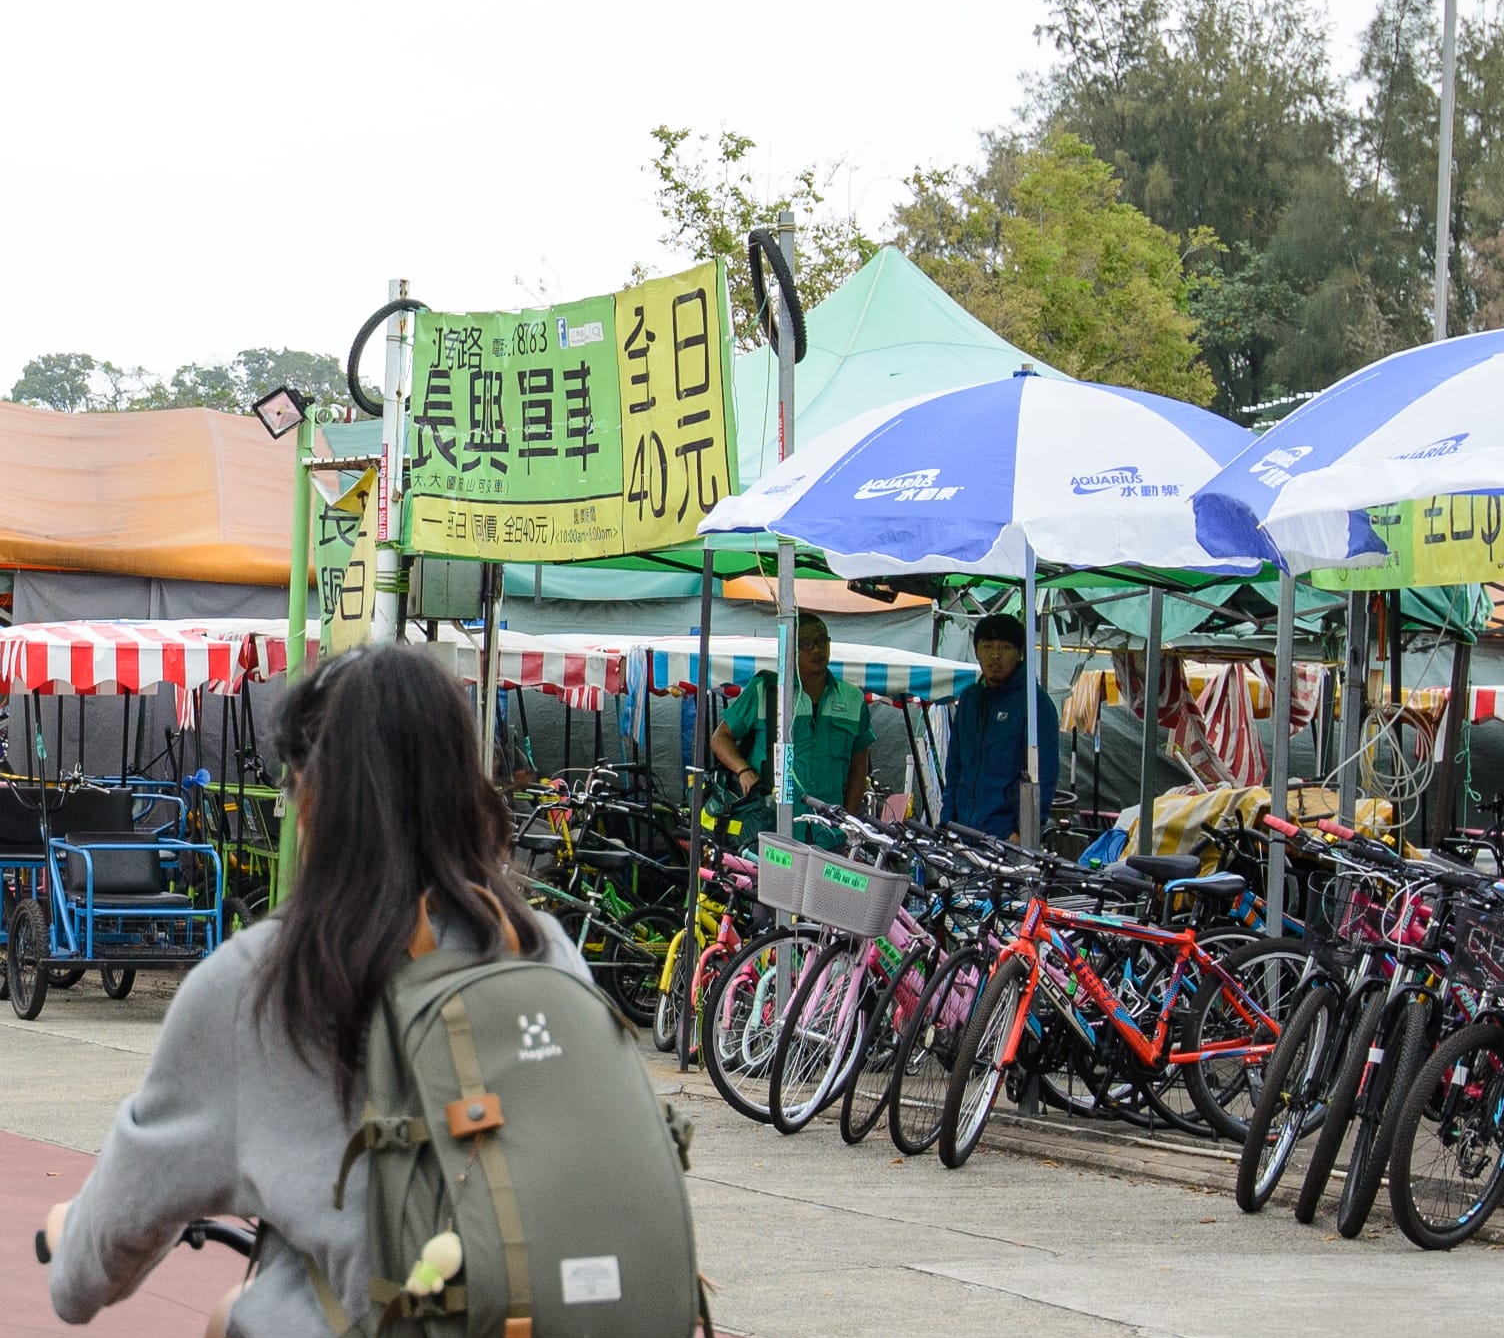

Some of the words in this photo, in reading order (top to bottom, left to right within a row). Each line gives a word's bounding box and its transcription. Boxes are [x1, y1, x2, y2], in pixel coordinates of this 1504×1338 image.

[411, 359, 600, 474] 長興單車
[858, 471, 937, 492] AQUARIUS
[1070, 469, 1144, 487] AQUARIUS
[1119, 483, 1180, 498] 水動樂
